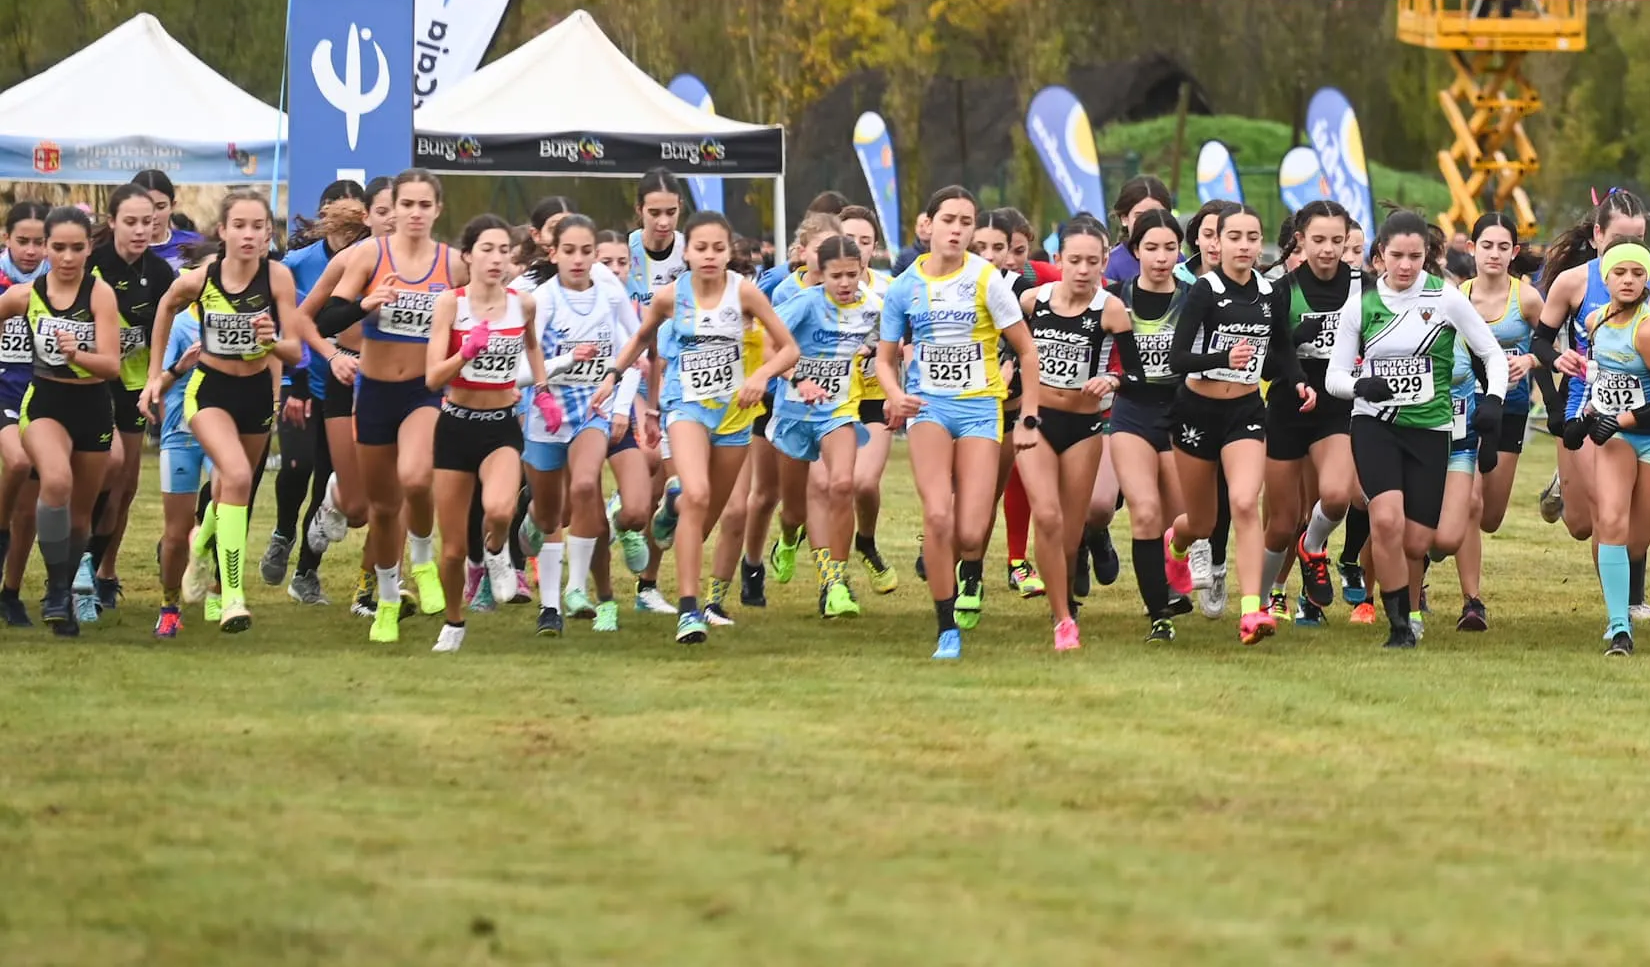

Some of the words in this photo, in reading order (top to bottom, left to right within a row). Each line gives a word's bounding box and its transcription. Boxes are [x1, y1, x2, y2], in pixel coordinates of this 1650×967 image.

[1034, 328, 1090, 346] WOLVES
[1218, 323, 1270, 336] WOLVES
[472, 356, 516, 371] 5326
[683, 354, 738, 371] BURGOS
[923, 352, 978, 362] BURGOS
[1374, 357, 1426, 368] DIPUTACIÓN
[691, 365, 733, 389] 5249
[930, 364, 971, 380] 5251
[1374, 366, 1427, 376] BURGOS
[1389, 376, 1422, 394] 329
[469, 410, 506, 421] PRO
